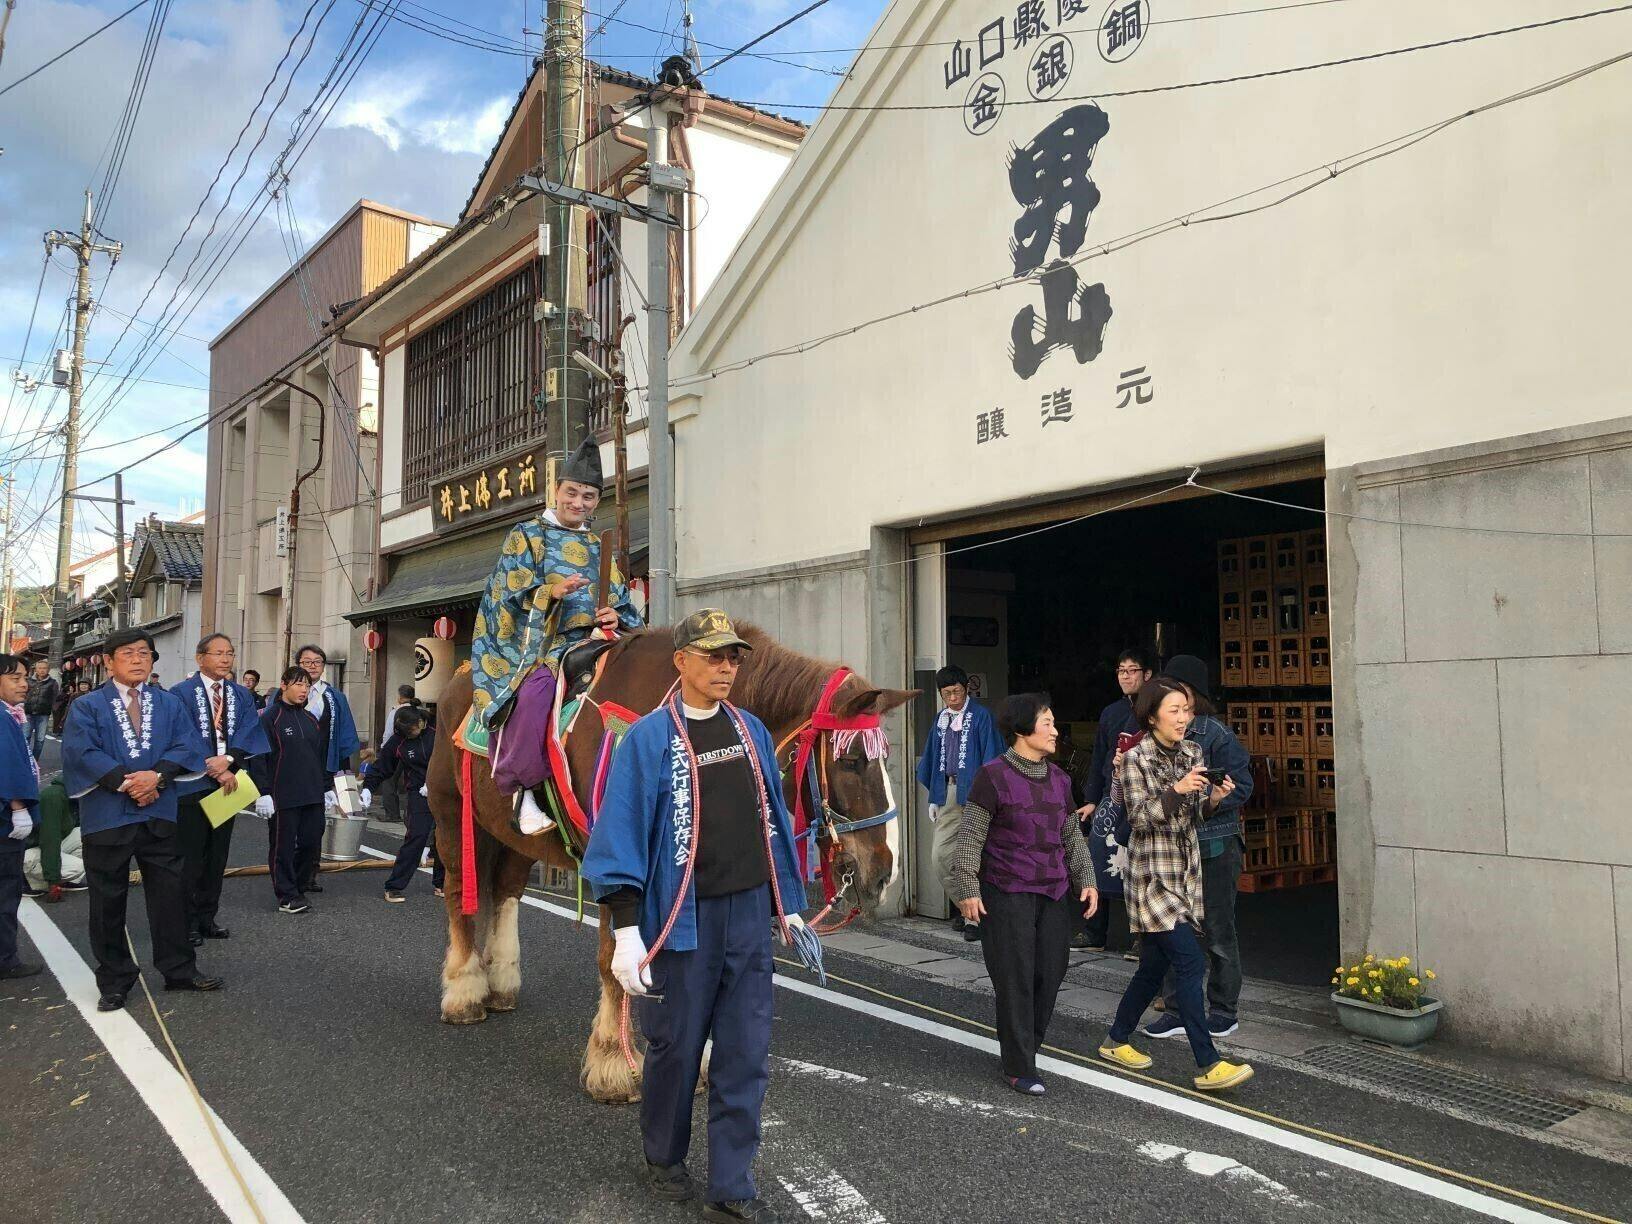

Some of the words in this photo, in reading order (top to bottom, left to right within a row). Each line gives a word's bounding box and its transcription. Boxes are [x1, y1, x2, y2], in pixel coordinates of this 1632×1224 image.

[1005, 99, 1113, 381] 男山
[671, 734, 693, 867] 古式行事保存会
